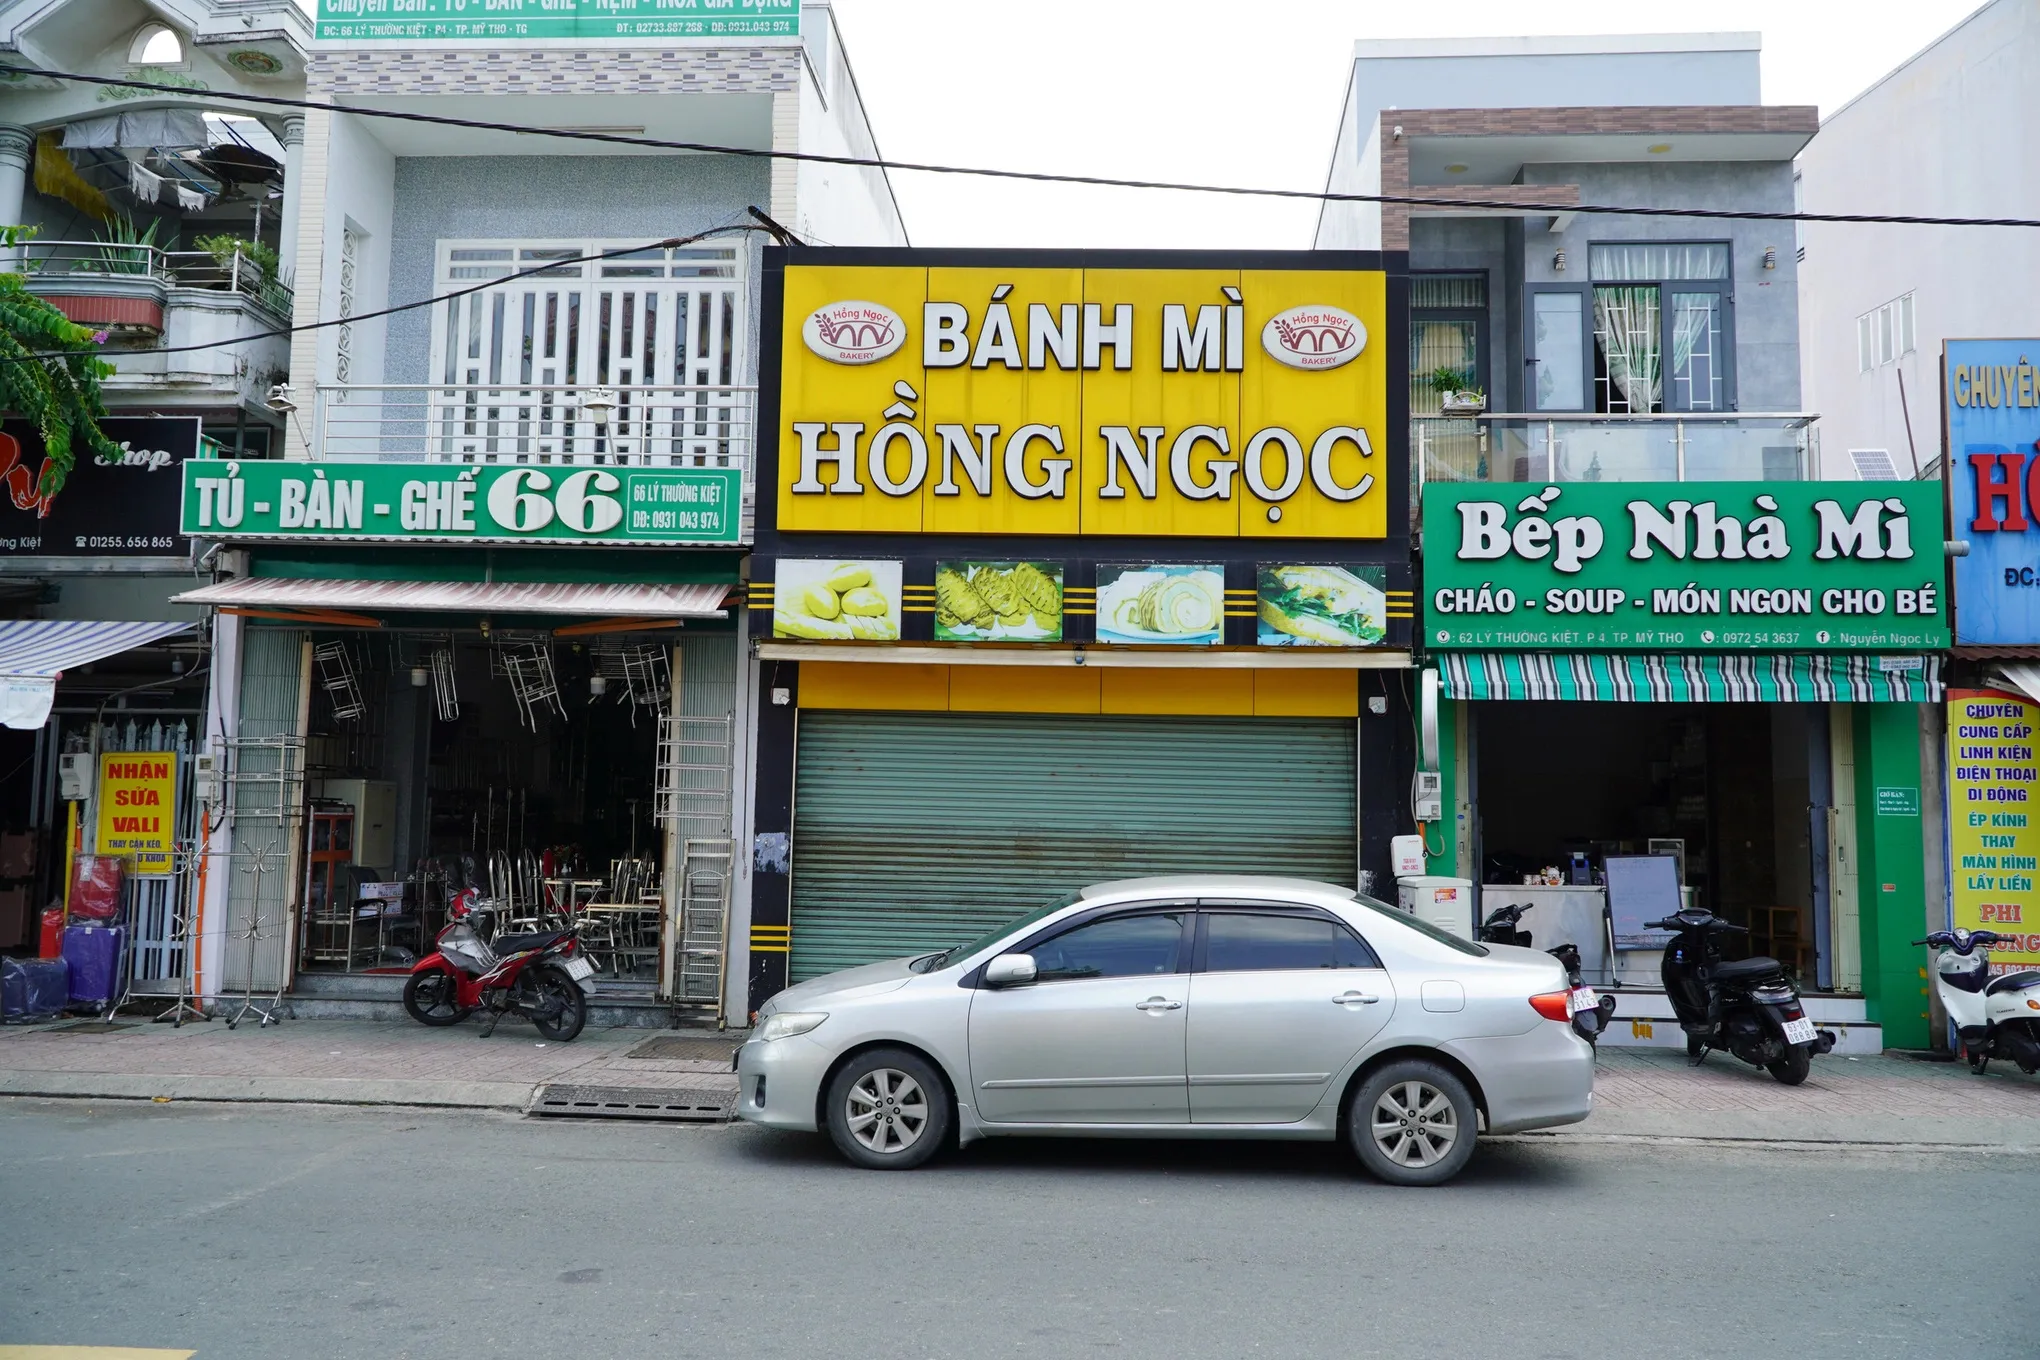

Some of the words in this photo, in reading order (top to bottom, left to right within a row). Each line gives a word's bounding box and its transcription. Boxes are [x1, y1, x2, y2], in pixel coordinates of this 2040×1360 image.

[341, 26, 352, 36] 66
[435, 25, 446, 35] P4
[456, 25, 469, 34] TP.
[472, 22, 485, 34] MỸ
[516, 24, 527, 34] TG
[773, 21, 790, 32] 974
[863, 309, 888, 323] Ngọc
[1323, 313, 1348, 326] Ngọc
[923, 283, 1134, 371] BÁNH
[1162, 286, 1244, 373] MÌ
[840, 352, 875, 360] BAKERY
[1301, 356, 1336, 365] BAKERY
[792, 379, 1073, 499] HỒNG
[1099, 426, 1375, 524] NGỌC
[195, 462, 245, 528] TỦ
[279, 469, 364, 529] BÀN
[401, 467, 482, 531] GHẾ
[487, 468, 624, 533] 66
[634, 484, 646, 502] 66
[647, 481, 659, 502] LÝ
[700, 482, 721, 506] KIỆT
[652, 511, 676, 528] 0931
[679, 511, 698, 529] 043
[700, 512, 719, 529] 974
[1456, 486, 1604, 573] Bếp
[1626, 495, 1792, 561] Nhà
[1813, 497, 1915, 561] Mì
[20, 536, 42, 549] Kiệt
[151, 536, 173, 548] 865
[1435, 581, 1516, 613] CHÁO
[1545, 588, 1625, 613] SOUP
[1652, 582, 1720, 614] MÓN
[1730, 589, 1812, 614] NGON
[1822, 589, 1886, 614] CHO
[1895, 582, 1937, 614] BÉ
[1459, 632, 1473, 644] 62
[1613, 632, 1632, 644] TP.
[1636, 629, 1654, 643] MỸ
[1723, 632, 1750, 644] 0972
[1755, 632, 1768, 644] 54
[1772, 632, 1800, 644] 3637
[1966, 702, 2024, 718] CHUYÊN
[1959, 726, 1999, 738] CUNG
[2003, 722, 2032, 738] CẤP
[1960, 746, 1993, 759] LINH
[1998, 744, 2032, 762] KIỆN
[108, 761, 168, 782] NHẬN
[1956, 765, 1990, 782] ĐIỆN
[1995, 767, 2037, 783] THOẠI
[115, 786, 160, 806] SỬA
[1968, 788, 1982, 801] DI
[1987, 786, 2027, 804] ĐỘNG
[112, 817, 159, 832] VALI
[1969, 811, 1987, 826] ÉP
[1992, 812, 2027, 827] KÍNH
[108, 840, 126, 849] THAY
[1981, 835, 2016, 848] THAY
[1962, 853, 1997, 869] MÀN
[2001, 854, 2036, 870] HÌNH
[1968, 873, 1994, 889] LẤY
[1980, 903, 2022, 923] PHI
